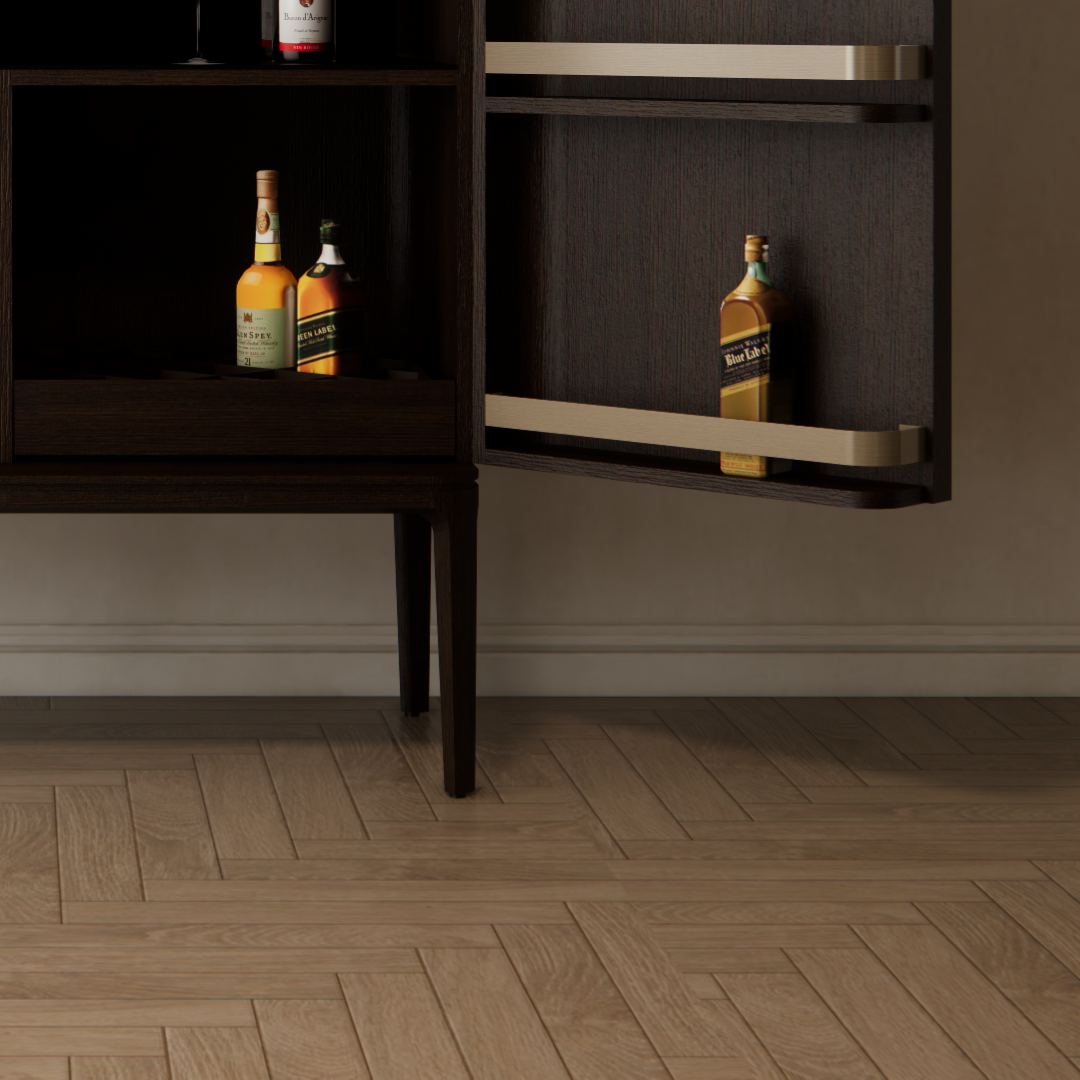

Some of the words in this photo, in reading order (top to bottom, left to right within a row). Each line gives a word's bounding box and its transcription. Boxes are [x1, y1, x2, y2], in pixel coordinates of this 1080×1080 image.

[245, 358, 251, 366] 21
[724, 353, 745, 367] Blue
[743, 343, 770, 360] Label
